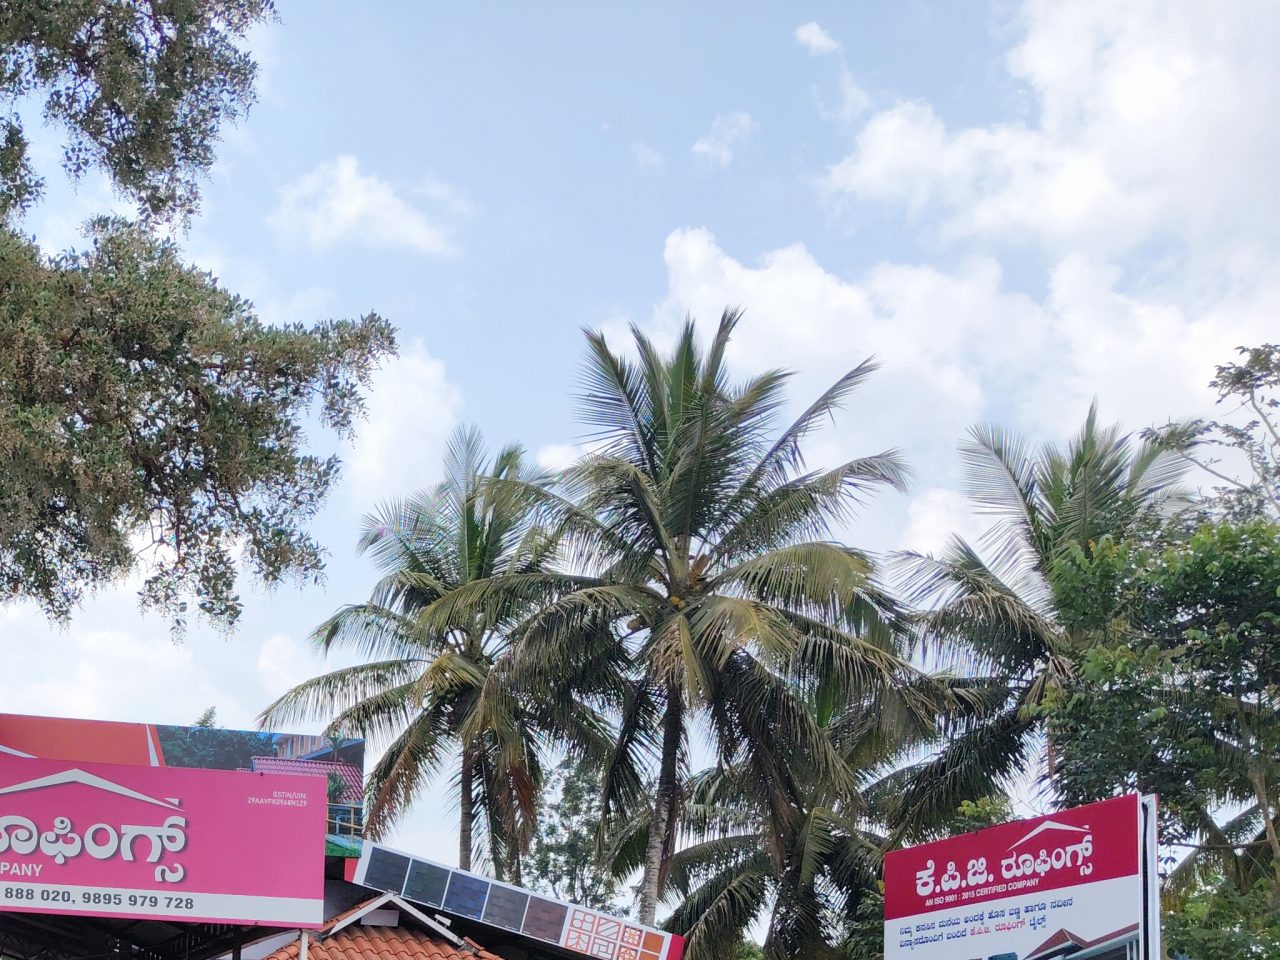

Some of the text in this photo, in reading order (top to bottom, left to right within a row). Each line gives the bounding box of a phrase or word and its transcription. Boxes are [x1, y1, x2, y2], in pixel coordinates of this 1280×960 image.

[915, 857, 994, 897] ಕೆ.ಪಿ.ಜಿ.
[4, 887, 35, 901] 888
[40, 889, 76, 904] 020,
[82, 892, 122, 906] 9895
[128, 894, 158, 908] 979
[164, 896, 194, 910] 728
[925, 899, 934, 907] AN
[934, 897, 944, 905] ISO
[945, 894, 958, 903] 9001
[962, 891, 975, 900] 2015
[976, 884, 1007, 897] CERTIFIED
[1007, 878, 1040, 891] COMPANY
